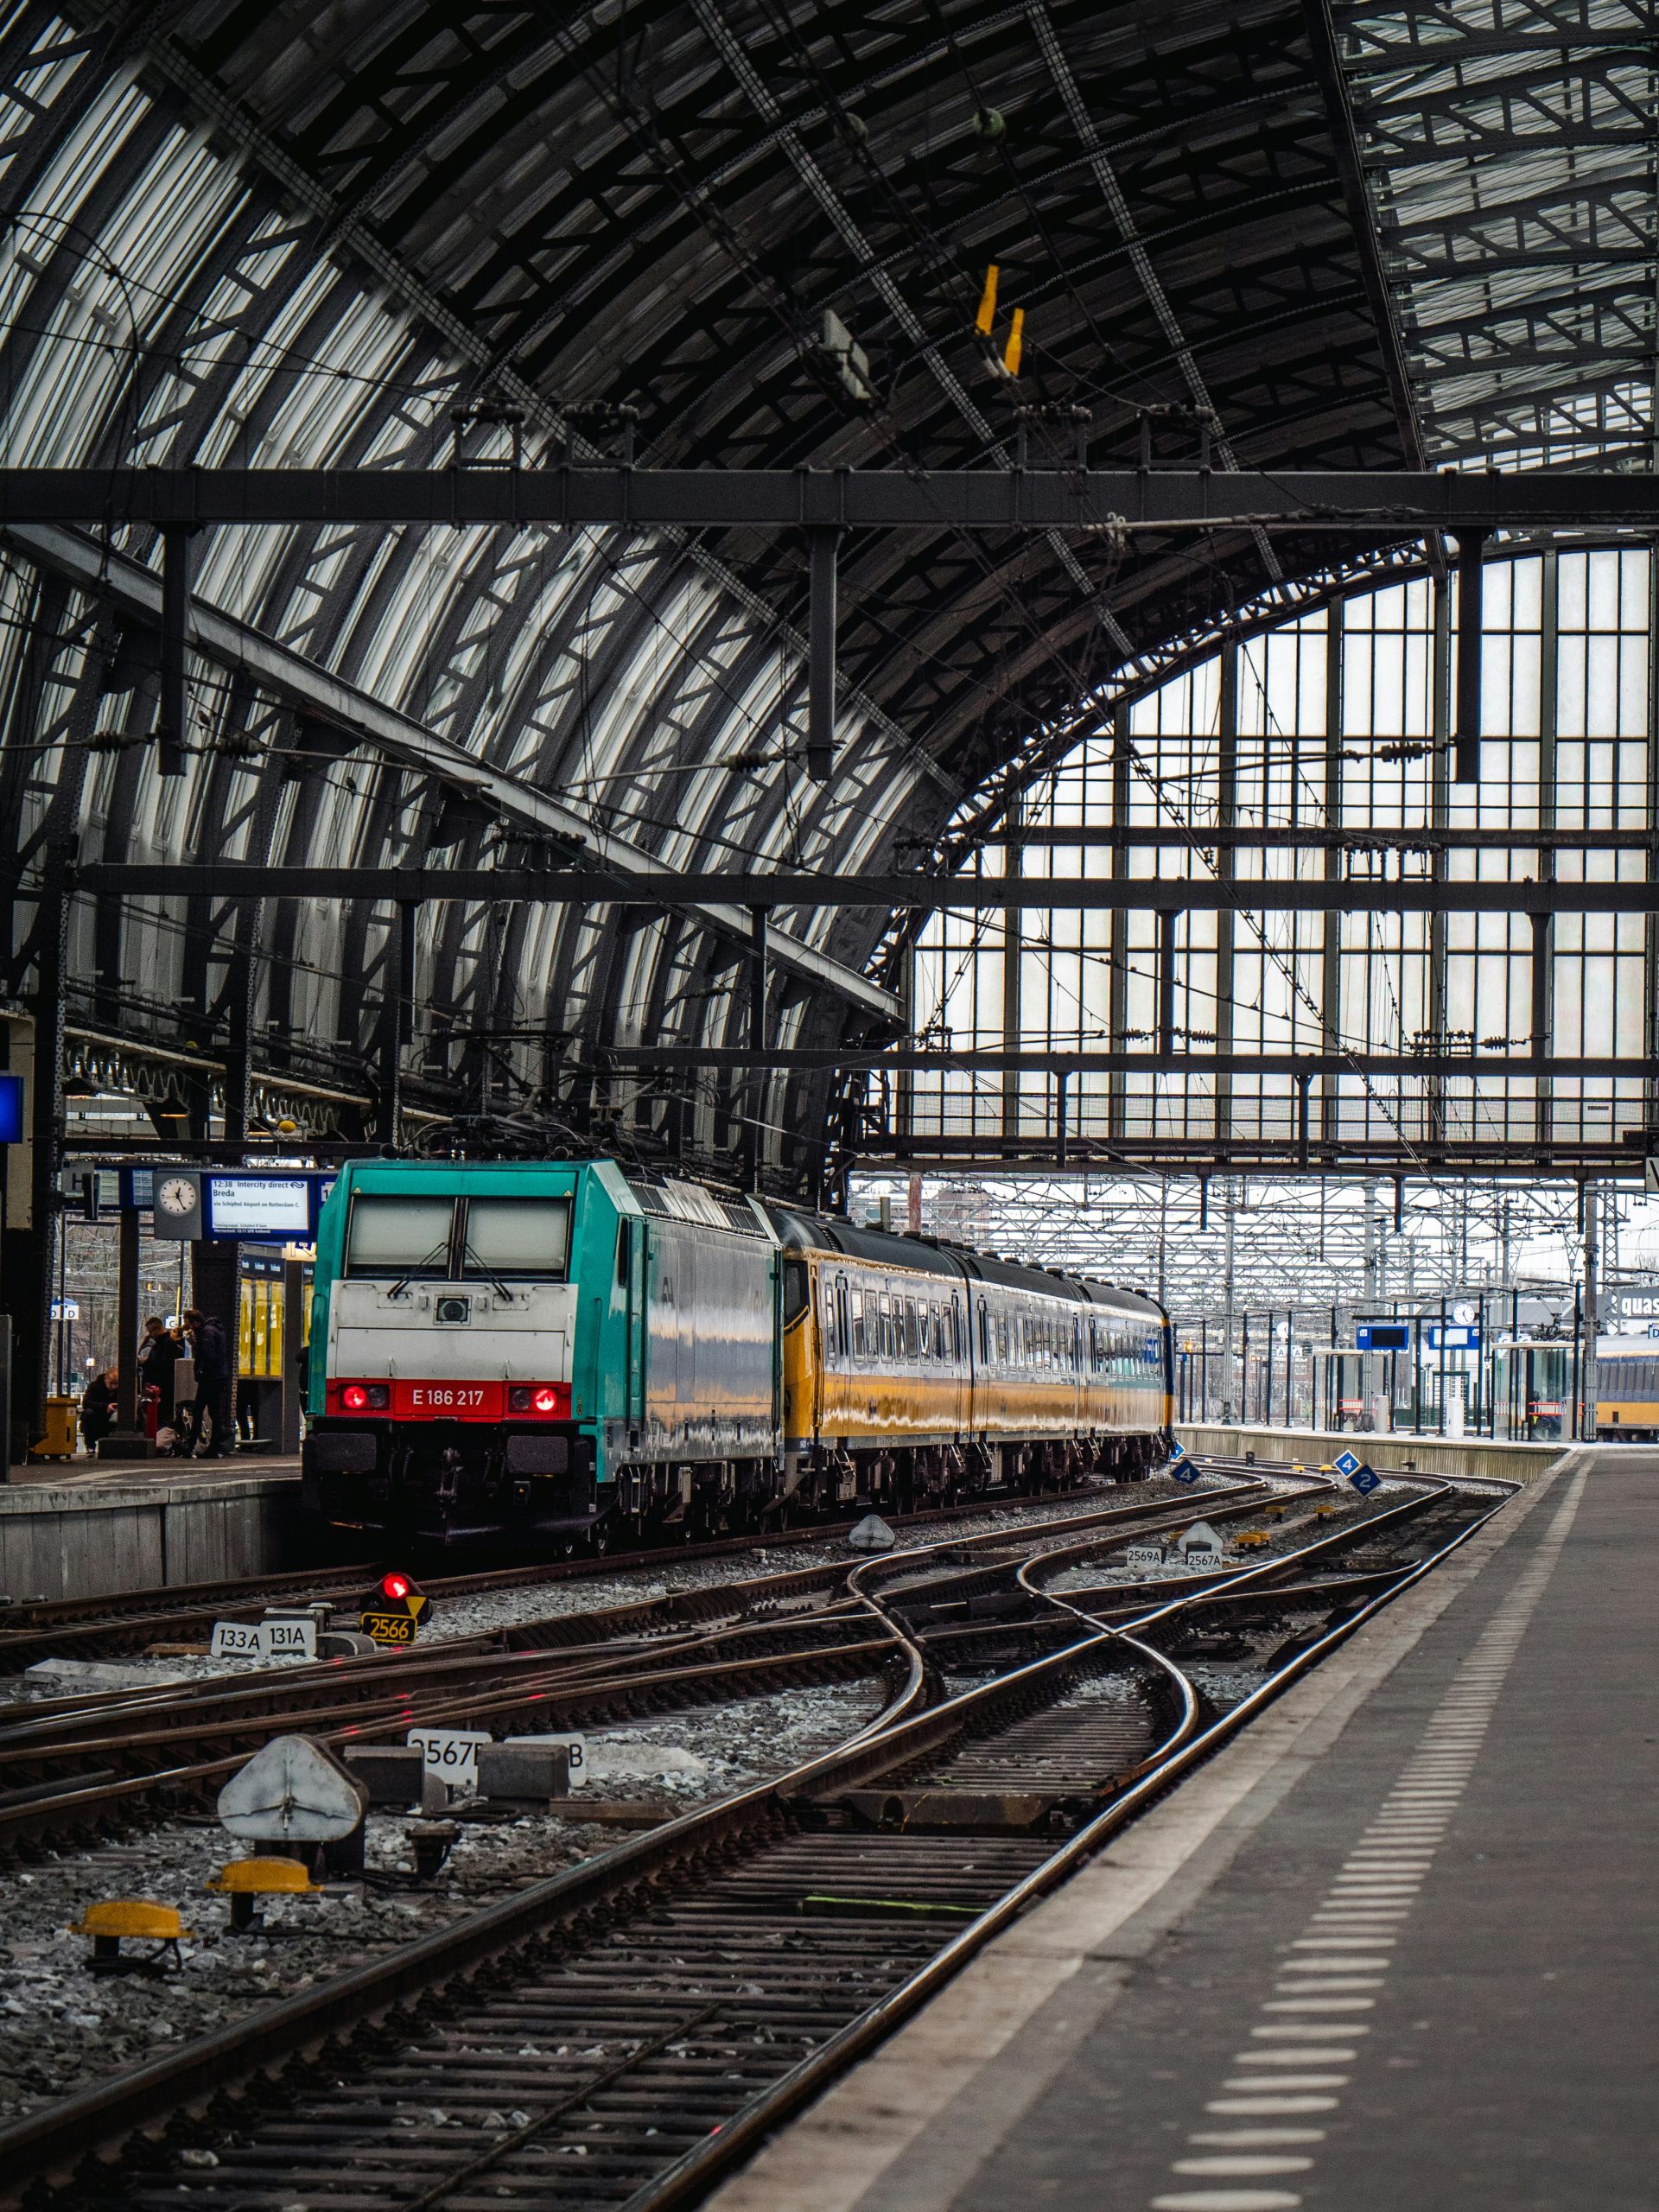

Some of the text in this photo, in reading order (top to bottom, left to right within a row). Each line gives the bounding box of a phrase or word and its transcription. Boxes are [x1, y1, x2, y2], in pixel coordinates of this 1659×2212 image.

[67, 1310, 75, 1319] D
[413, 1389, 484, 1406] E 186 217
[1342, 1459, 1352, 1470] 4
[1179, 1468, 1192, 1480] 4
[1359, 1473, 1371, 1487] 2
[1128, 1550, 1160, 1562] 2569A
[1189, 1555, 1221, 1566] 2567A
[370, 1618, 409, 1639] 2566
[219, 1629, 260, 1650] 133A
[270, 1627, 305, 1644] 131A
